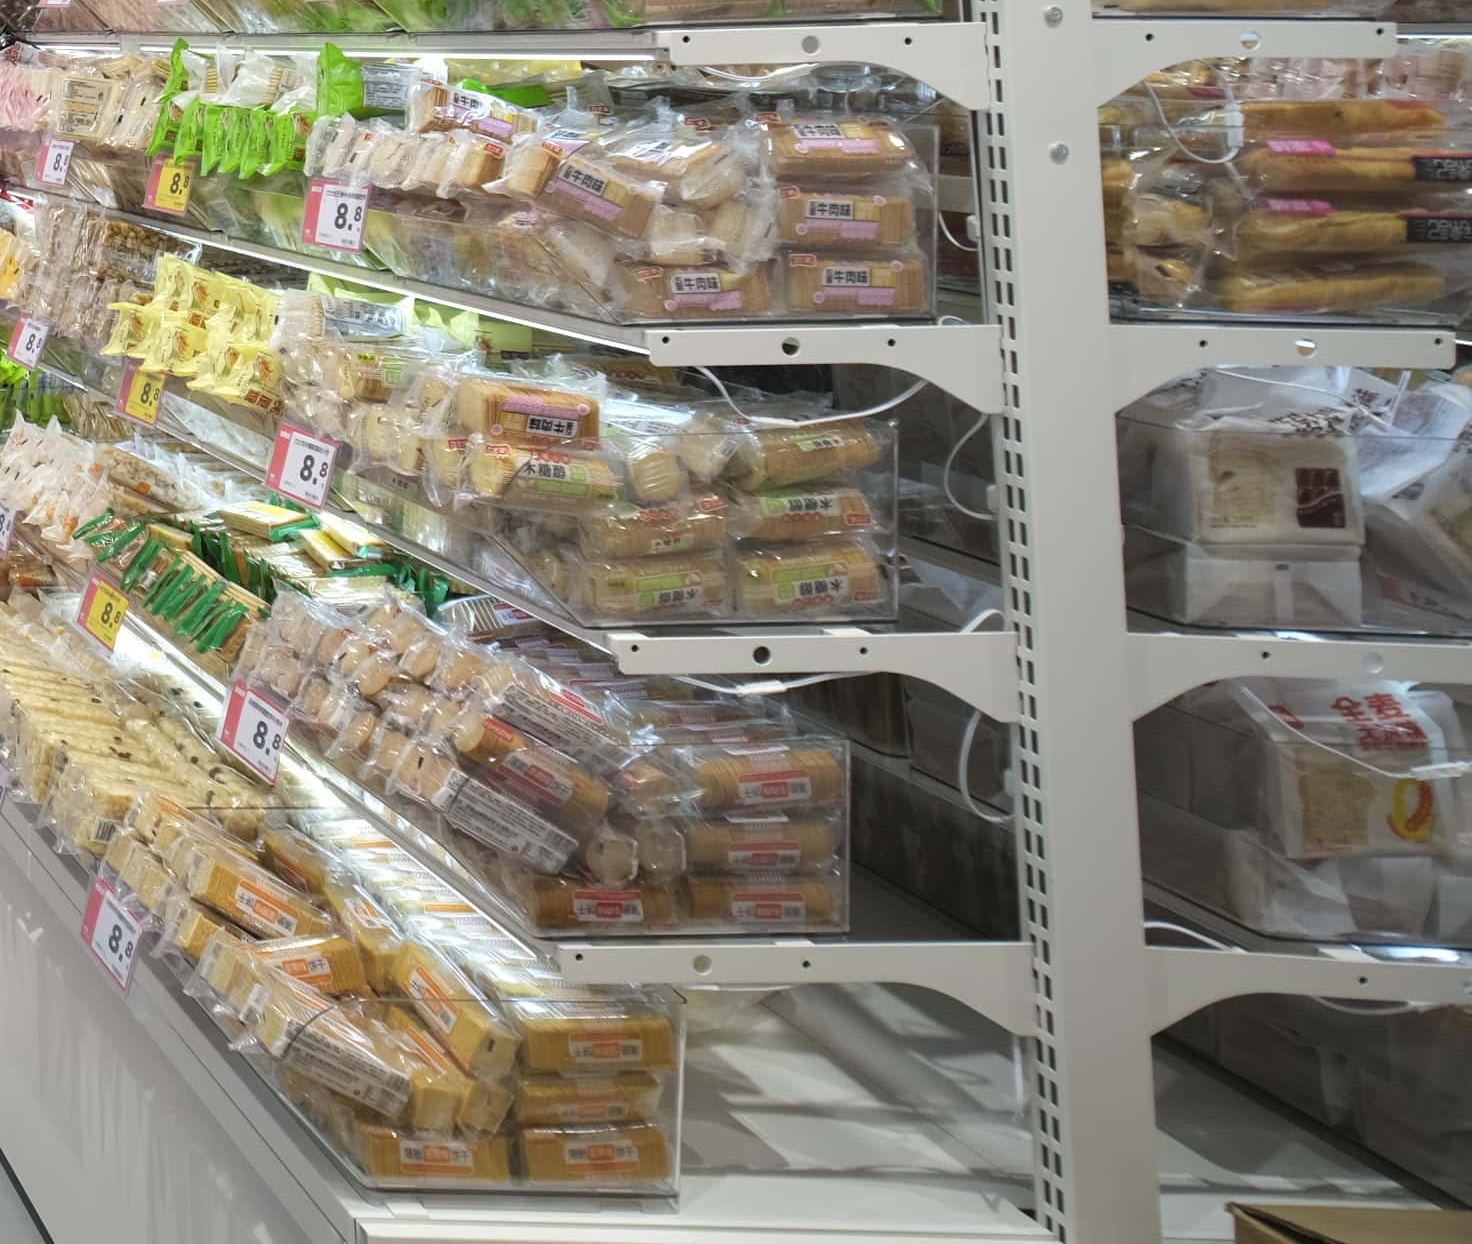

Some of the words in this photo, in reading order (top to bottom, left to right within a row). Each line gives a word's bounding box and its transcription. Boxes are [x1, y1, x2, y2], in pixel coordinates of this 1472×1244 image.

[170, 171, 189, 196] 8.8
[333, 202, 362, 231] 8.8
[24, 330, 44, 353] 8.8
[140, 382, 158, 406] 8.8
[299, 453, 329, 484] 8.8
[100, 602, 122, 626] 8.8
[254, 722, 282, 752] 8.8
[107, 922, 134, 961] 8.8
